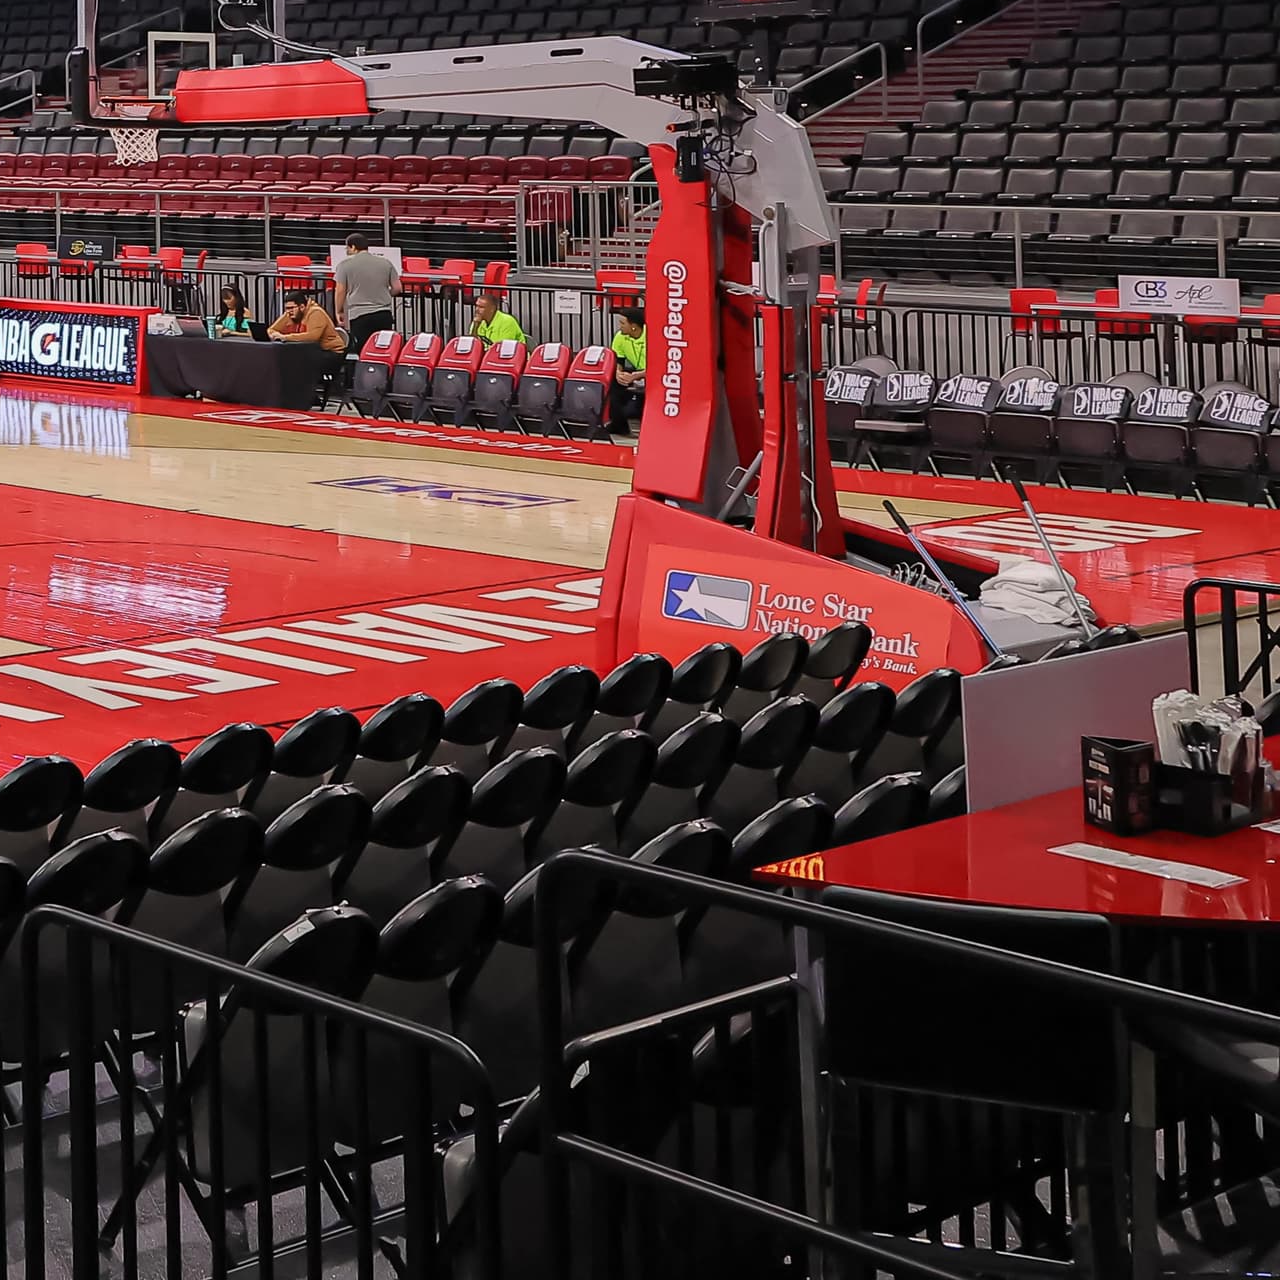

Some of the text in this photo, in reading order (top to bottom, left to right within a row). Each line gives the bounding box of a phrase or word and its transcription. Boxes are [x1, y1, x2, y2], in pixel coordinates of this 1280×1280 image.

[31, 322, 61, 366] G
[61, 324, 131, 372] LEAGUE
[663, 261, 688, 418] @nbagleague
[841, 386, 868, 401] LEAGUE
[903, 385, 930, 400] LEAGUE
[955, 390, 986, 407] LEAGUE
[1091, 400, 1122, 415] LEAGUE
[1156, 402, 1190, 418] LEAGUE
[1230, 408, 1265, 426] LEAGUE
[757, 583, 873, 622] Lone Star
[753, 609, 828, 642] Nation
[882, 659, 918, 675] Bank.
